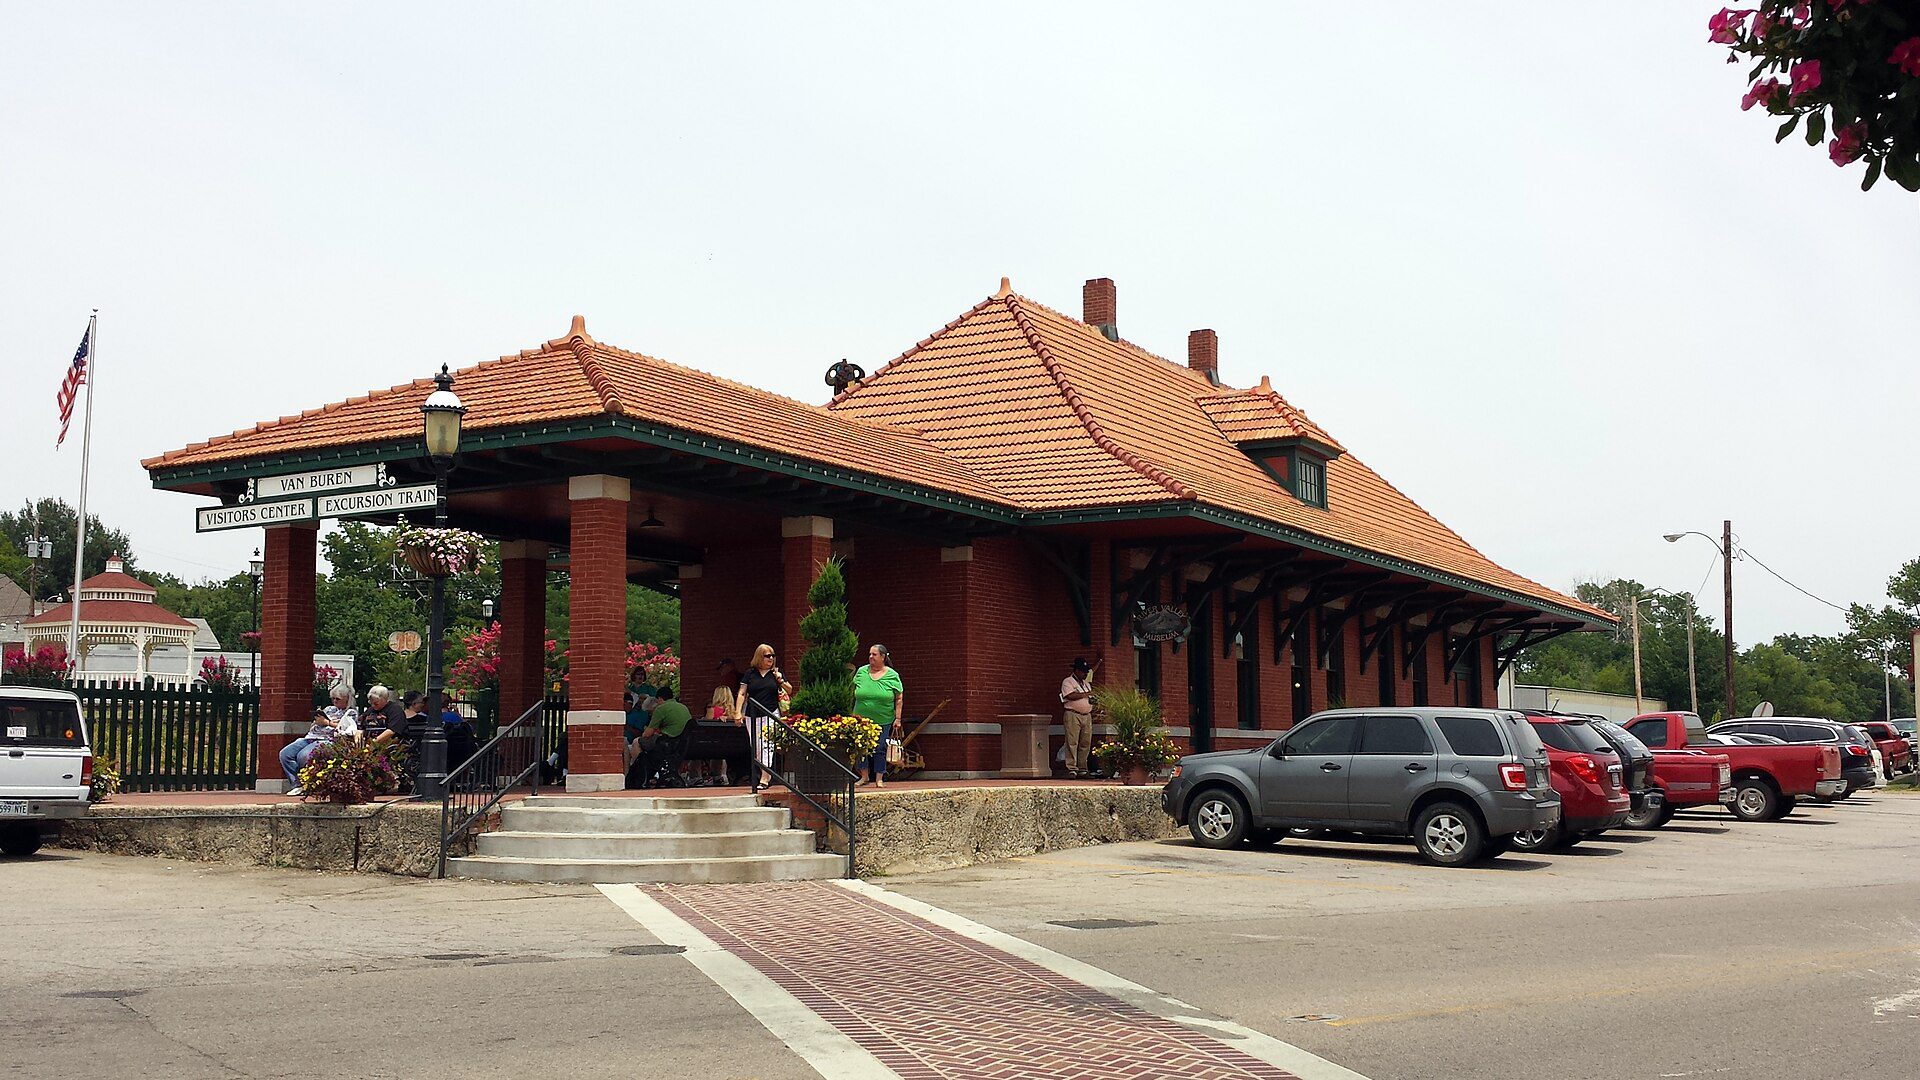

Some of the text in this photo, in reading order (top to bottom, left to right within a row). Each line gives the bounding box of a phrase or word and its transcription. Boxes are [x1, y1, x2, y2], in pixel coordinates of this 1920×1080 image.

[281, 471, 352, 491] VAN BUREN
[325, 488, 436, 511] EXCURSION TRAIN
[206, 503, 305, 525] VISITORS CENTER
[1143, 630, 1180, 641] MUSEUM
